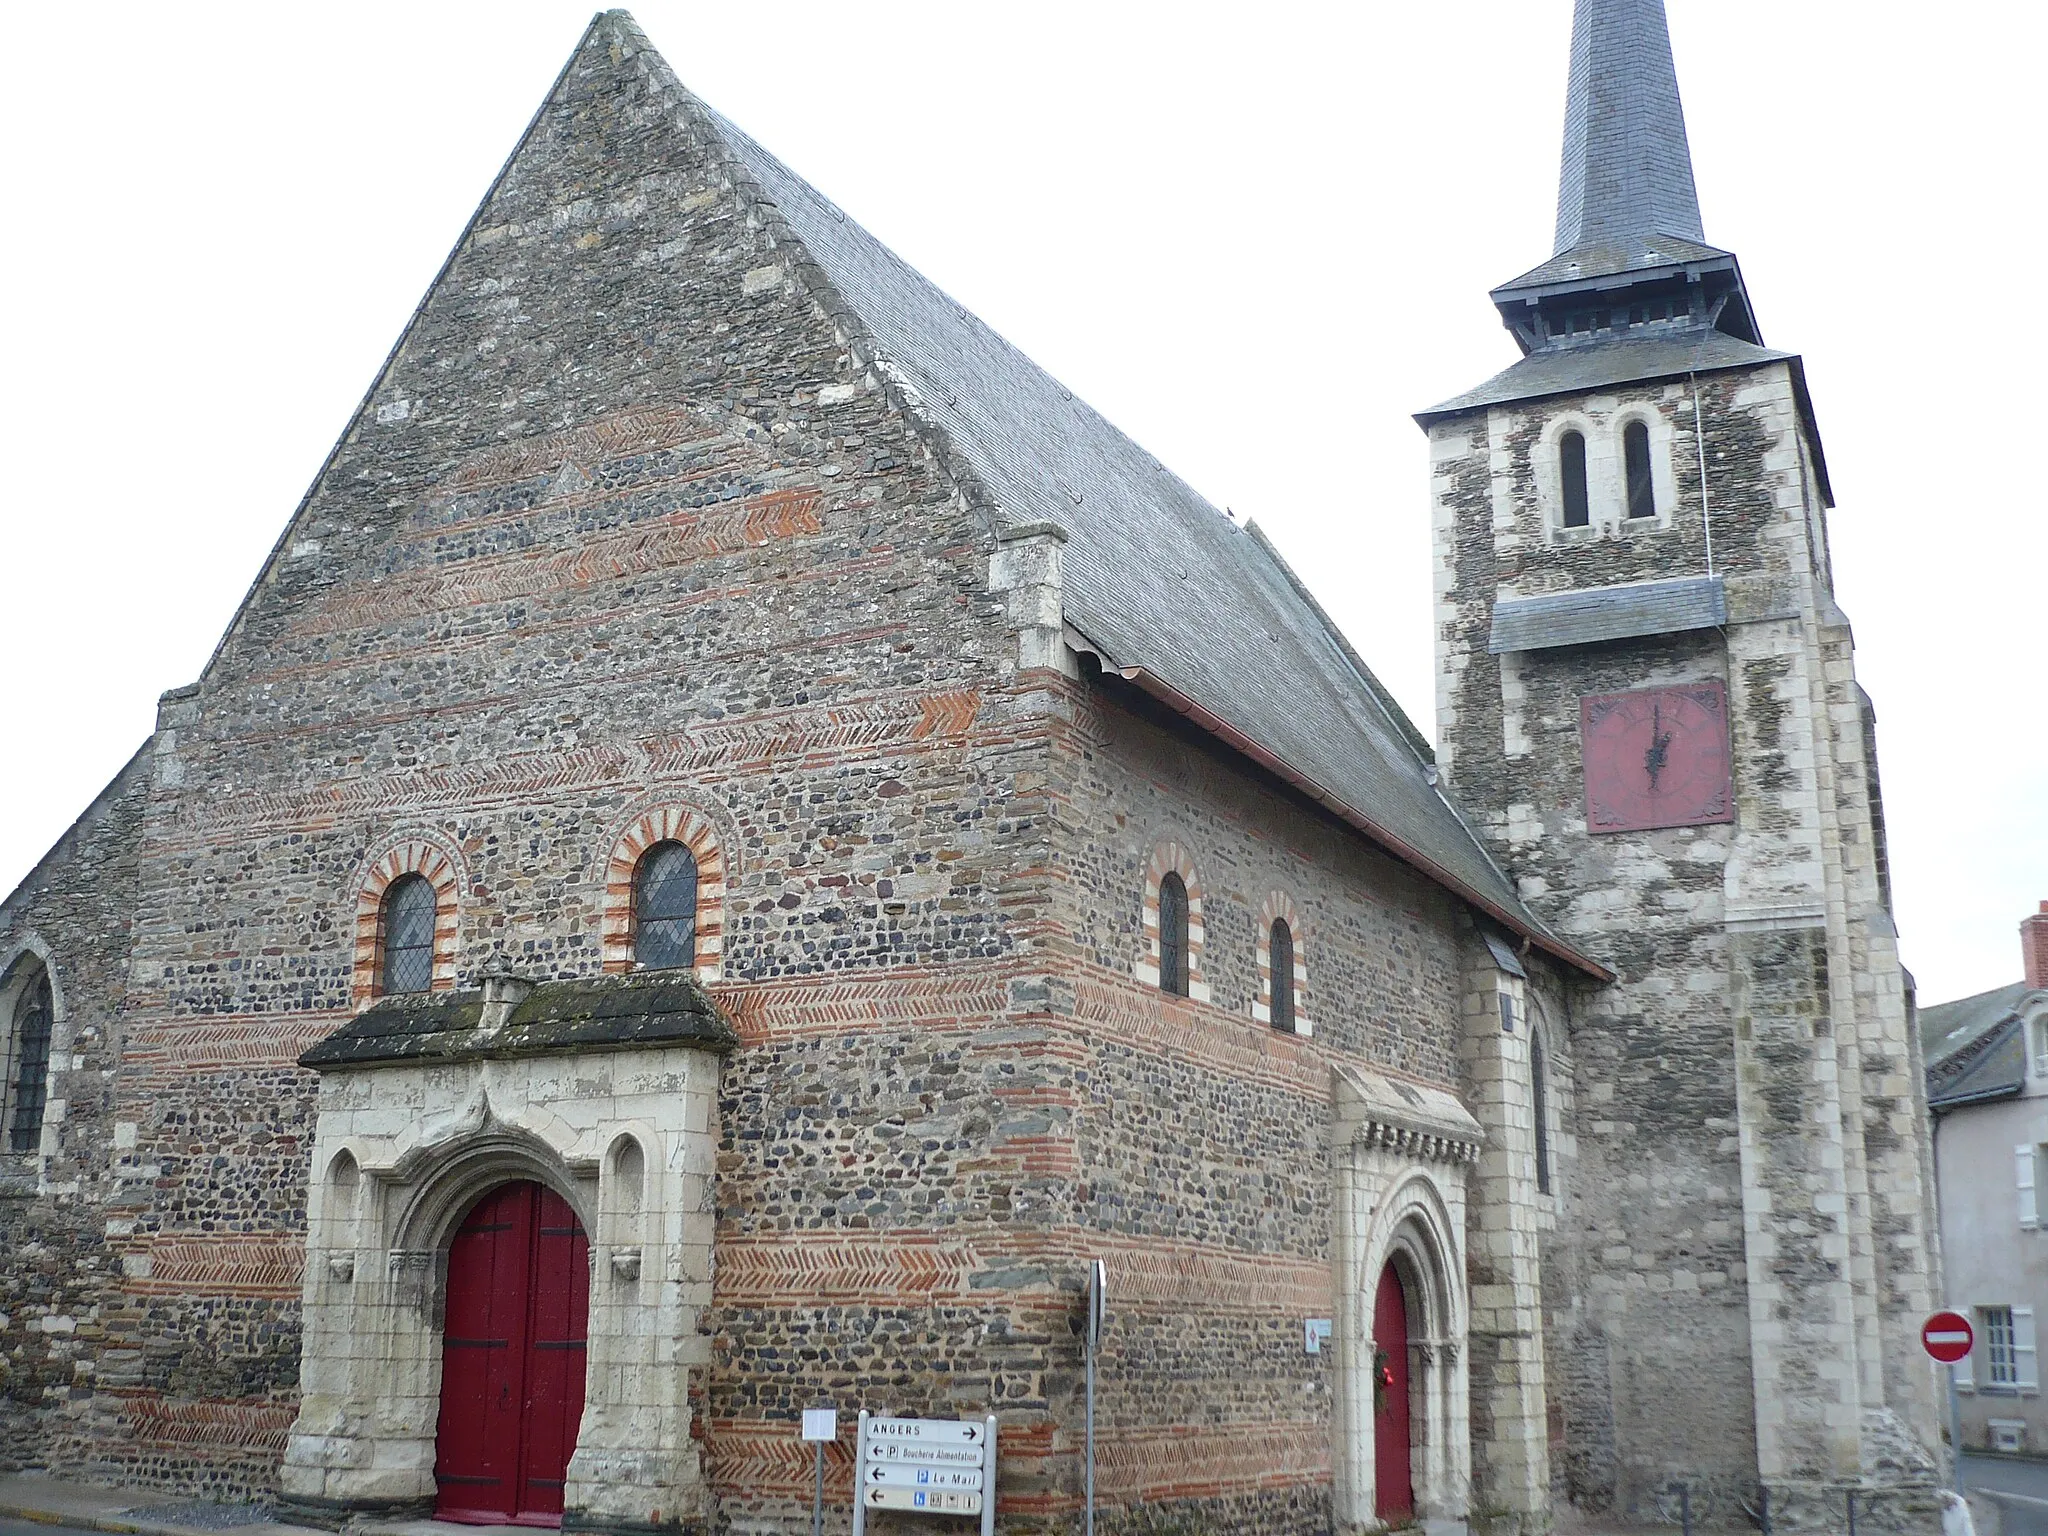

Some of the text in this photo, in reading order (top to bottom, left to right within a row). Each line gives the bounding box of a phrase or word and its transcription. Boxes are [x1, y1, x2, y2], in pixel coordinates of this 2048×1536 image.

[873, 1424, 920, 1435] ANGERS
[903, 1448, 934, 1459] Boucherie
[933, 1472, 945, 1483] Le
[951, 1474, 976, 1485] Mail
